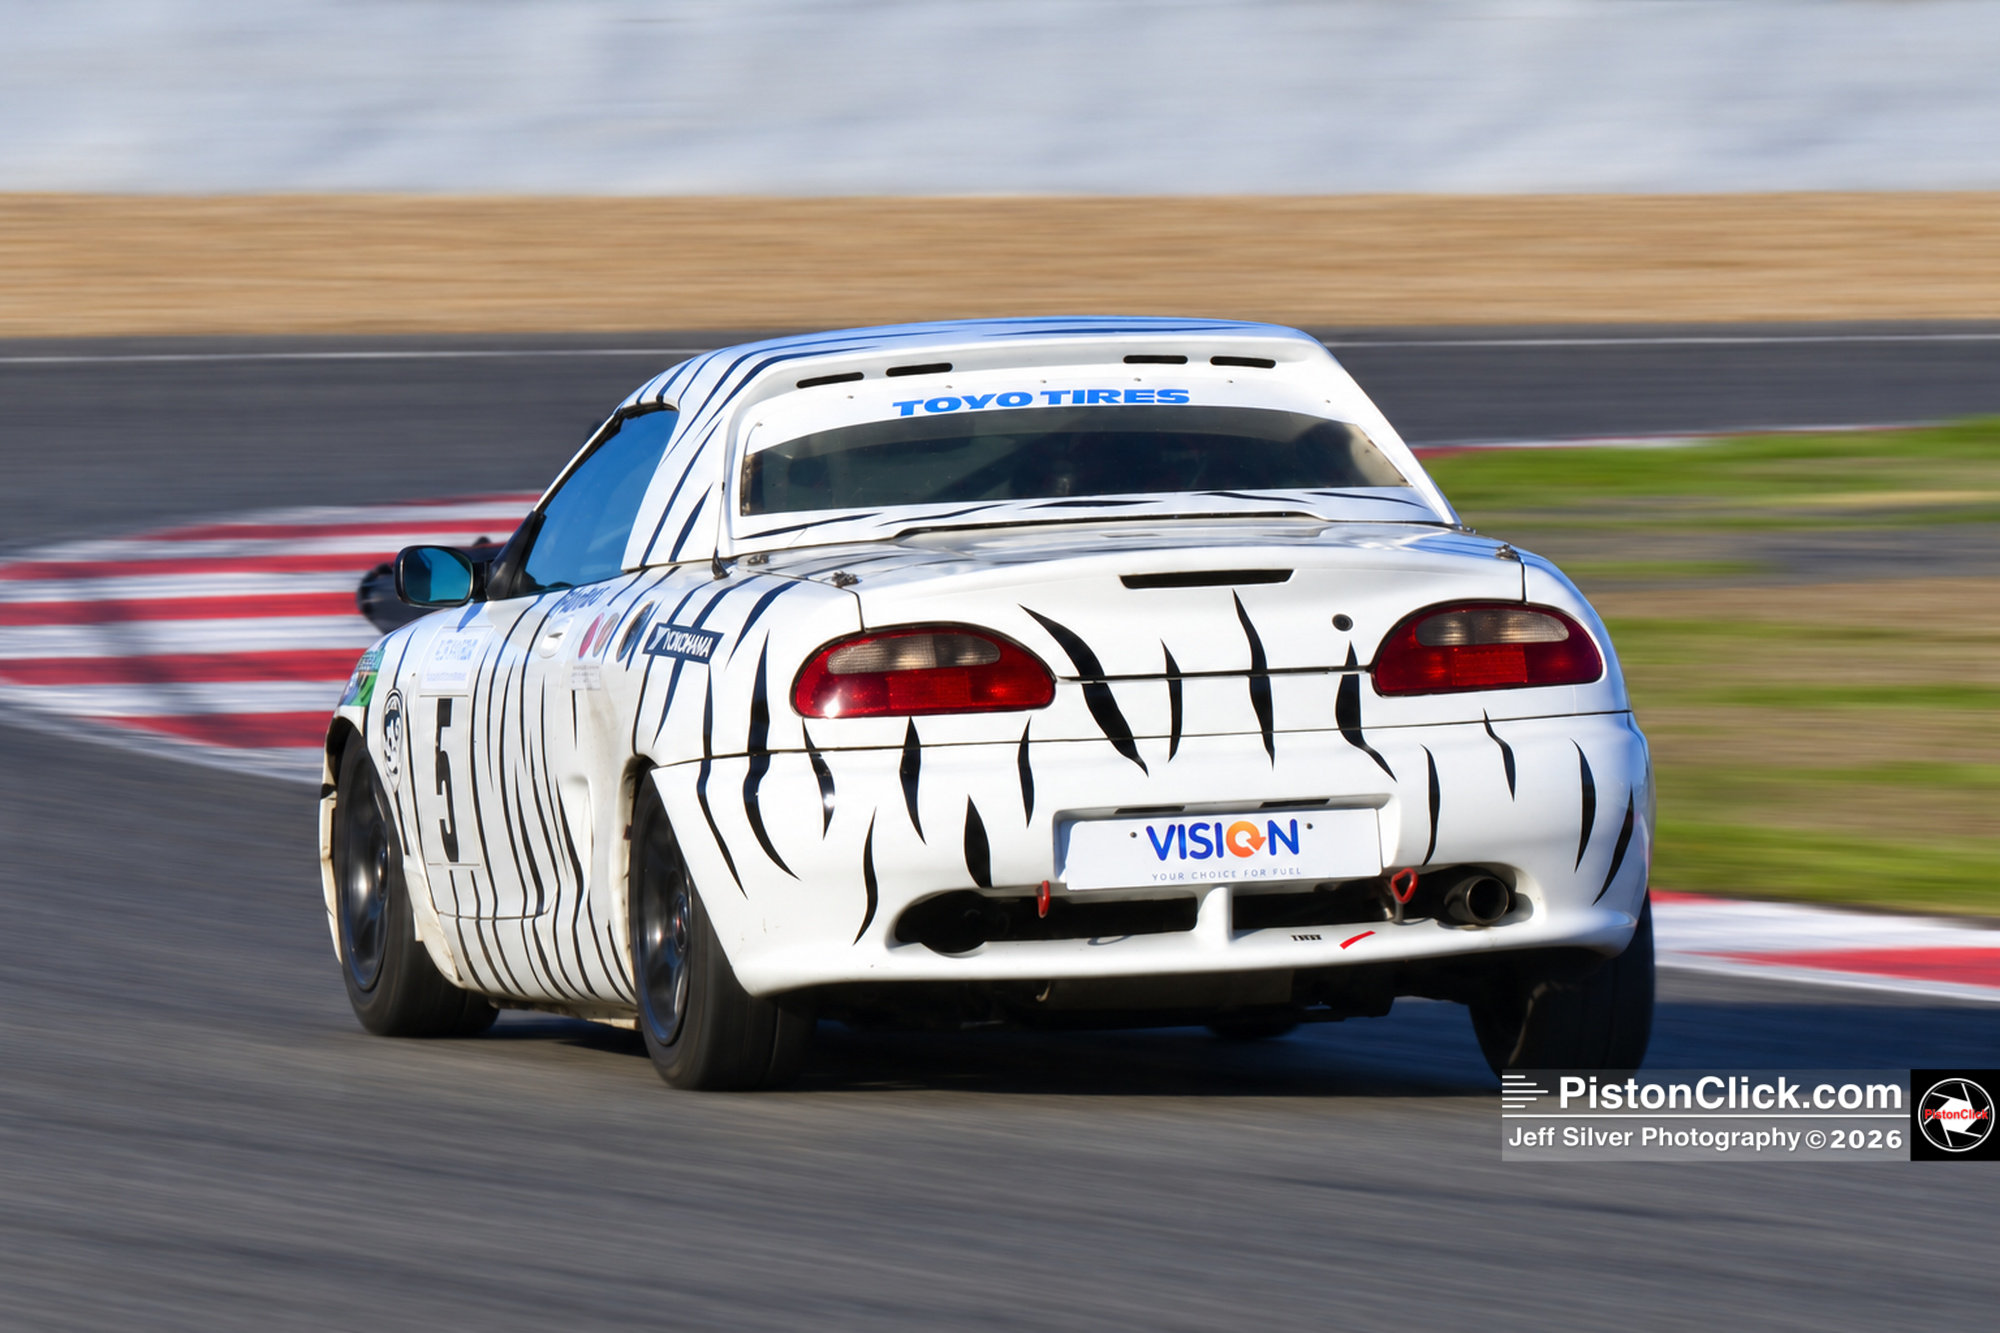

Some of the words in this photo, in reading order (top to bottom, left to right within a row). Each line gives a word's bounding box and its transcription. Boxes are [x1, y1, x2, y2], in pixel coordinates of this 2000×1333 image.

[892, 391, 1033, 417] TOYO
[1040, 389, 1190, 405] TIRES
[435, 698, 460, 863] 5
[1145, 818, 1300, 862] VISION
[1152, 872, 1185, 882] YOUR
[1191, 870, 1238, 880] CHOICE
[1244, 868, 1267, 878] FOR
[1273, 867, 1302, 876] FUEL
